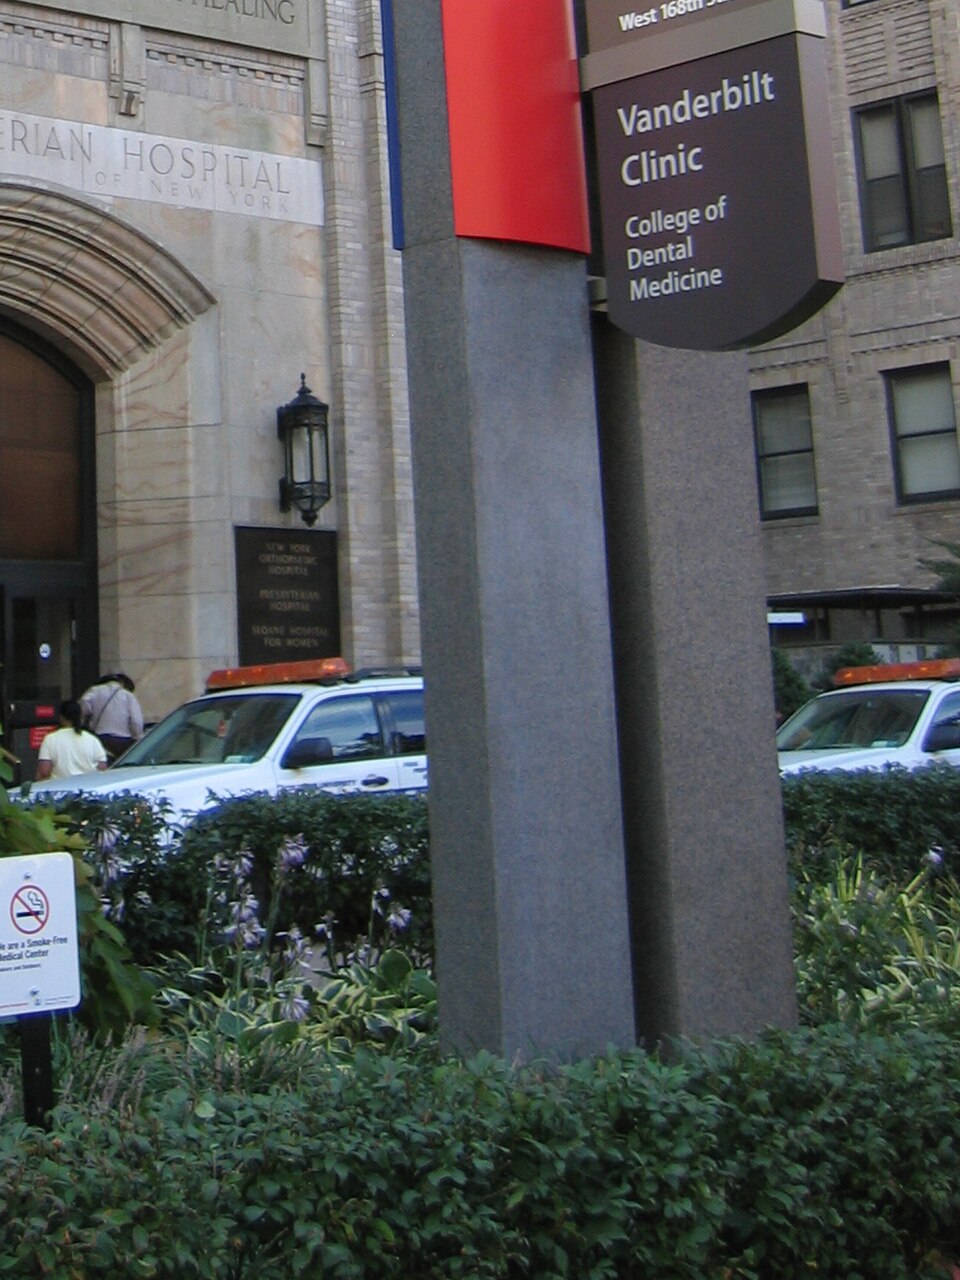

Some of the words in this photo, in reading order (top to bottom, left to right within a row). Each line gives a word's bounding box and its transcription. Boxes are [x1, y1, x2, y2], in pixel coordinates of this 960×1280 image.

[618, 4, 658, 33] West
[617, 71, 777, 139] Vanderbilt
[123, 136, 292, 196] HOSPITAL
[621, 143, 704, 188] Clinic
[94, 169, 121, 189] OF
[150, 175, 204, 201] NEW
[228, 187, 290, 213] YORK
[625, 200, 701, 241] College
[704, 195, 728, 223] of
[626, 236, 695, 273] Dental
[629, 266, 723, 302] Medicine
[7, 941, 18, 949] are
[26, 935, 68, 948] Smoke-Free
[24, 948, 50, 959] Center
